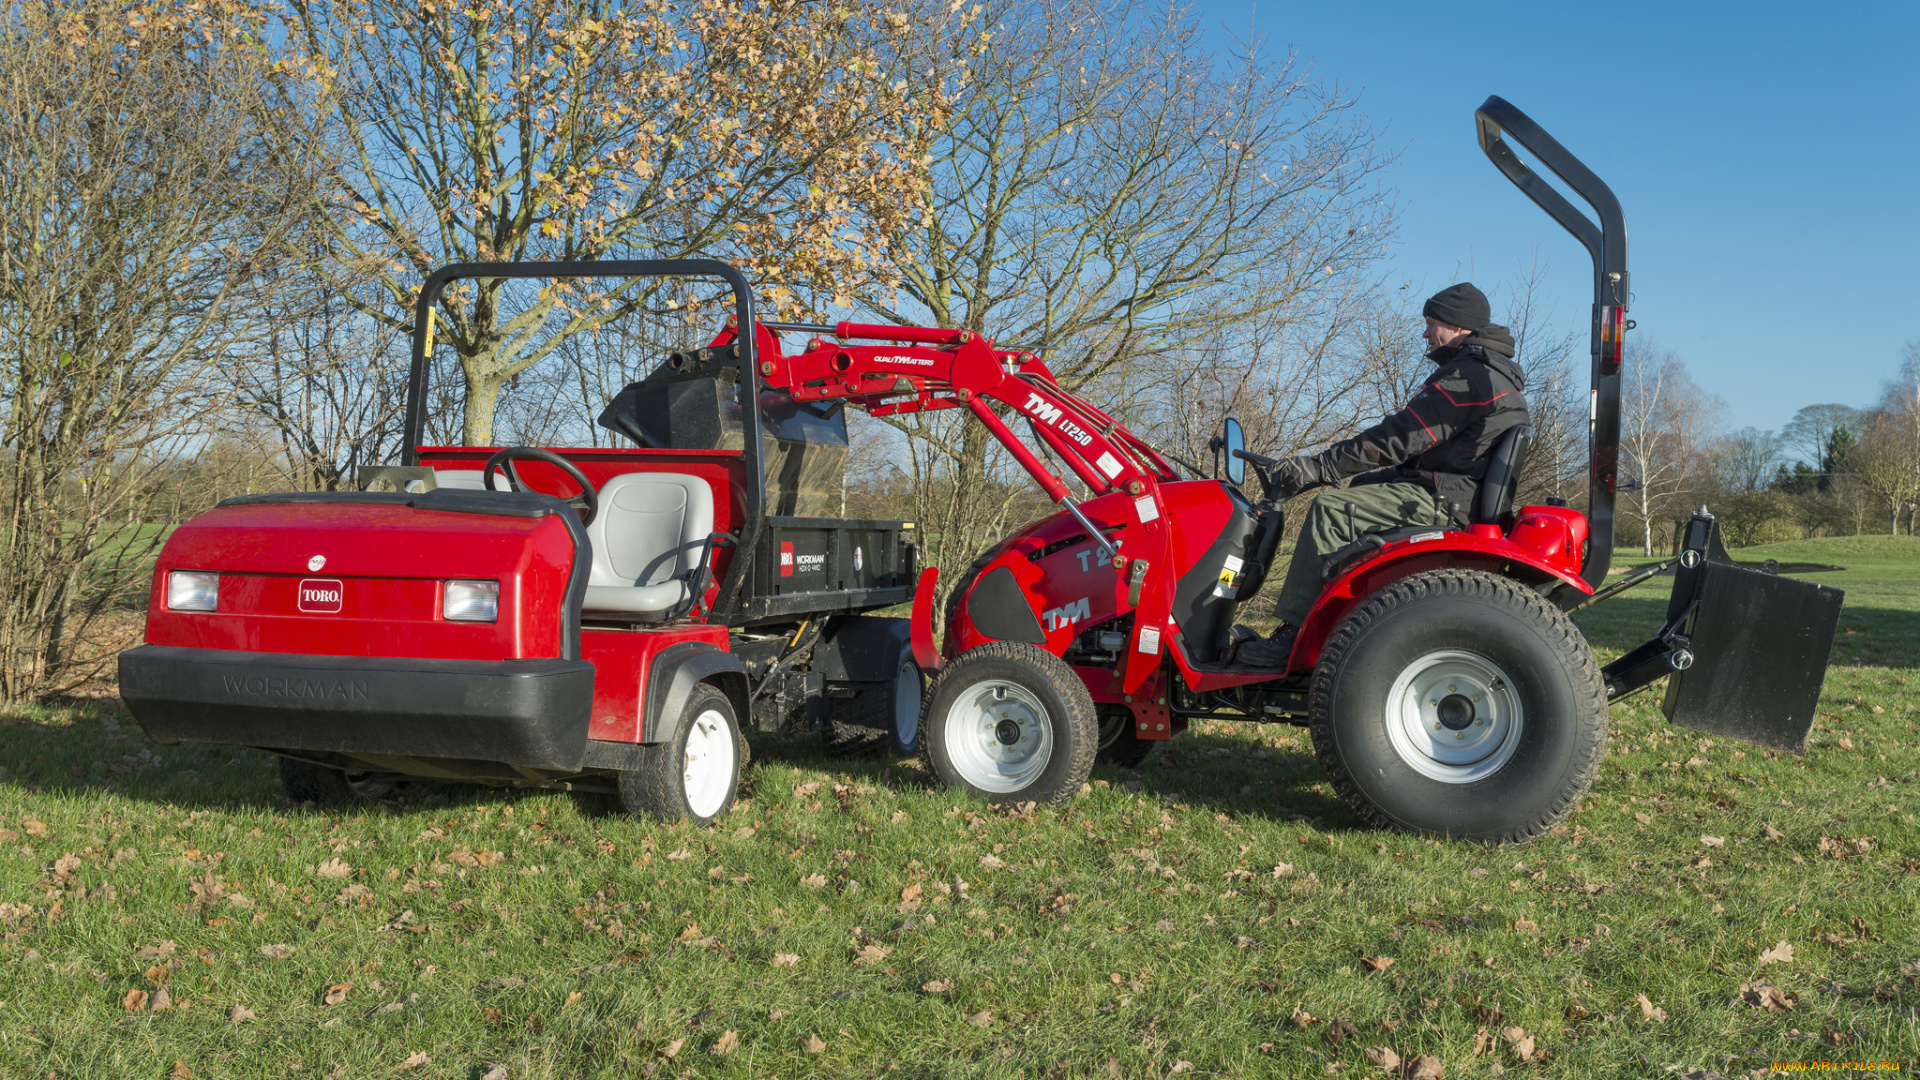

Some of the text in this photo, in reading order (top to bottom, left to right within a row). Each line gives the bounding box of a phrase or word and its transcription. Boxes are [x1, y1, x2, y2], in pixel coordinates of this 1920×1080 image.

[1023, 392, 1093, 447] TYM LT250
[797, 554, 825, 564] WORKMAN
[303, 589, 339, 602] TORO
[1042, 596, 1091, 633] TYM
[223, 675, 369, 699] WORKMAN
